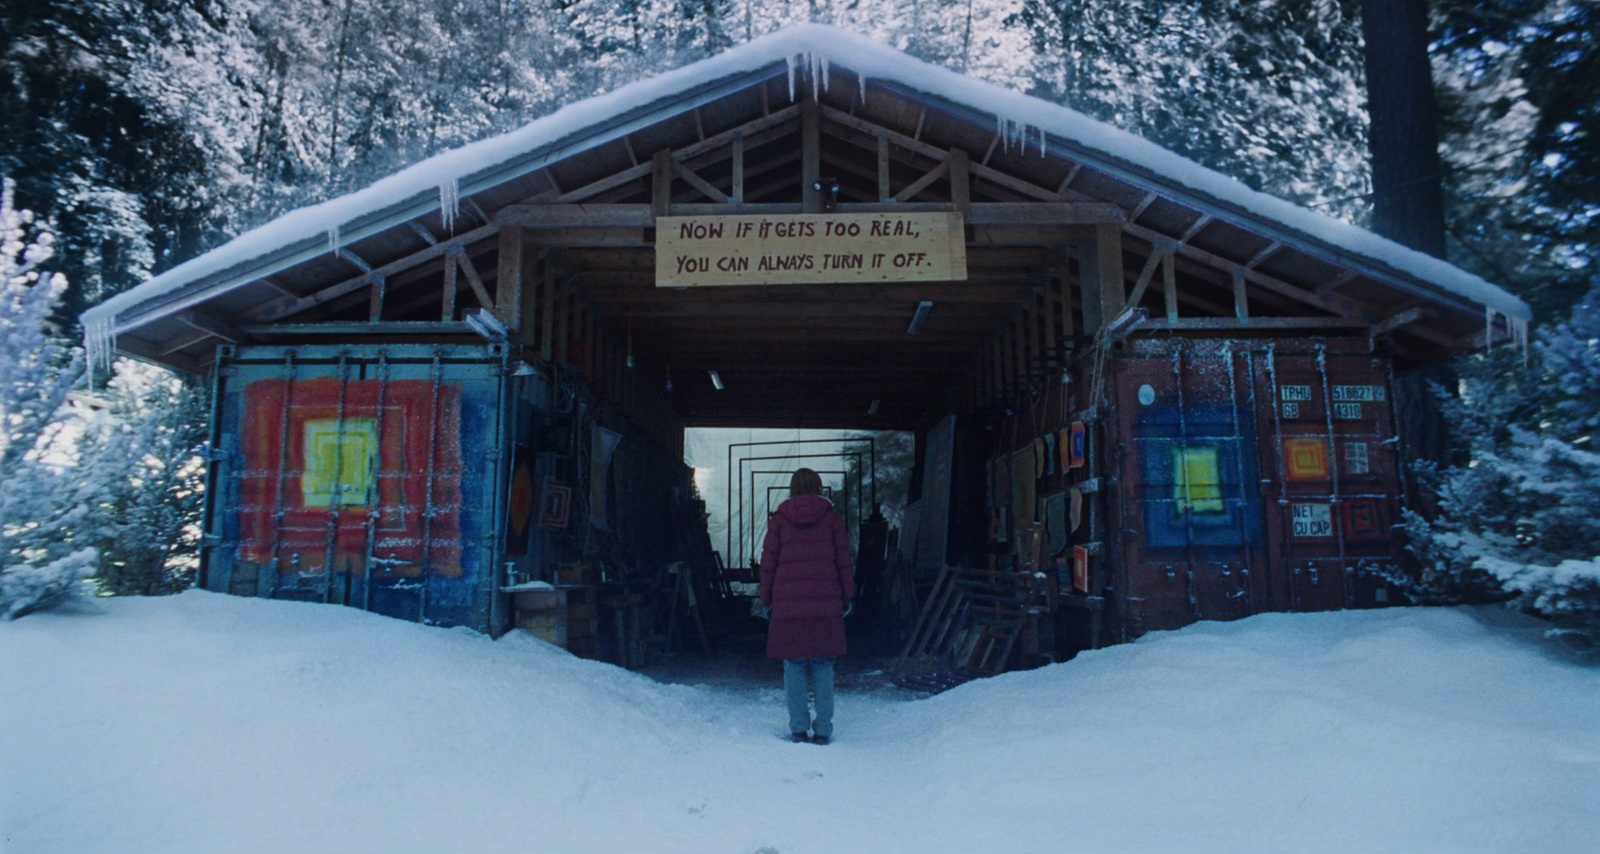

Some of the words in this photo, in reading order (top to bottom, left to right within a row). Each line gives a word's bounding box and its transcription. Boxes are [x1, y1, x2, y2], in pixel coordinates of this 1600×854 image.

[679, 221, 724, 239] NOW
[735, 222, 753, 238] IF
[825, 221, 861, 237] TOO
[870, 220, 920, 239] REAL,
[676, 255, 709, 274] YOU
[716, 256, 748, 271] CAN
[757, 254, 814, 271] ALWAYS
[823, 254, 863, 270] TURN
[871, 254, 885, 268] IT
[893, 253, 932, 268] OFF.
[1281, 386, 1310, 399] TPHU
[1335, 404, 1361, 418] 4310
[1293, 505, 1313, 517] NET
[1294, 521, 1307, 535] CU
[1310, 521, 1330, 535] CAP
